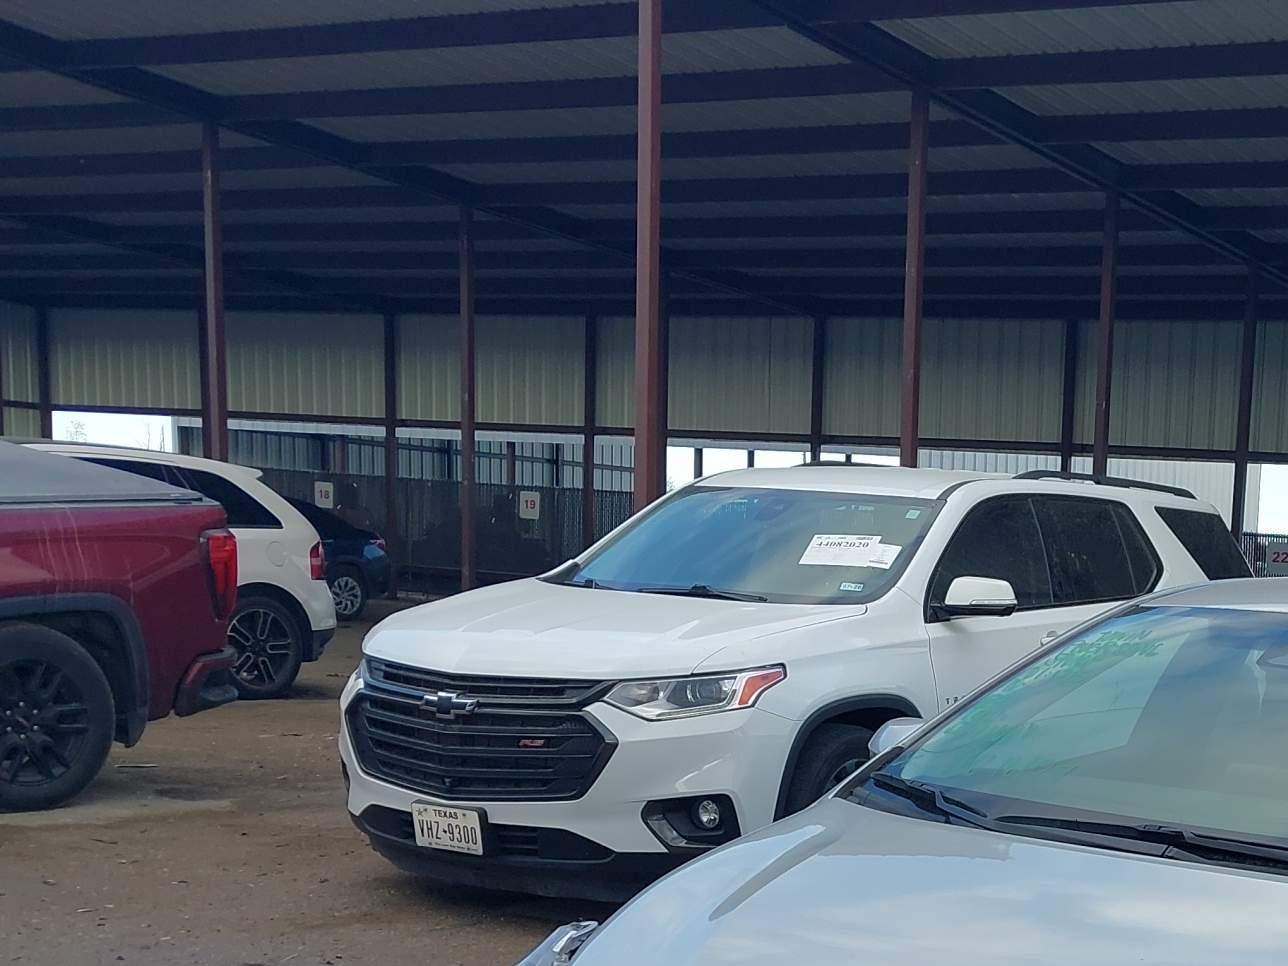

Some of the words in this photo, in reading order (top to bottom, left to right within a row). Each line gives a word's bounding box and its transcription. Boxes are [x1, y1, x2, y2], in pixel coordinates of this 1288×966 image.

[525, 499, 536, 510] 19
[1272, 551, 1288, 564] 22
[432, 808, 459, 820] TEXAS
